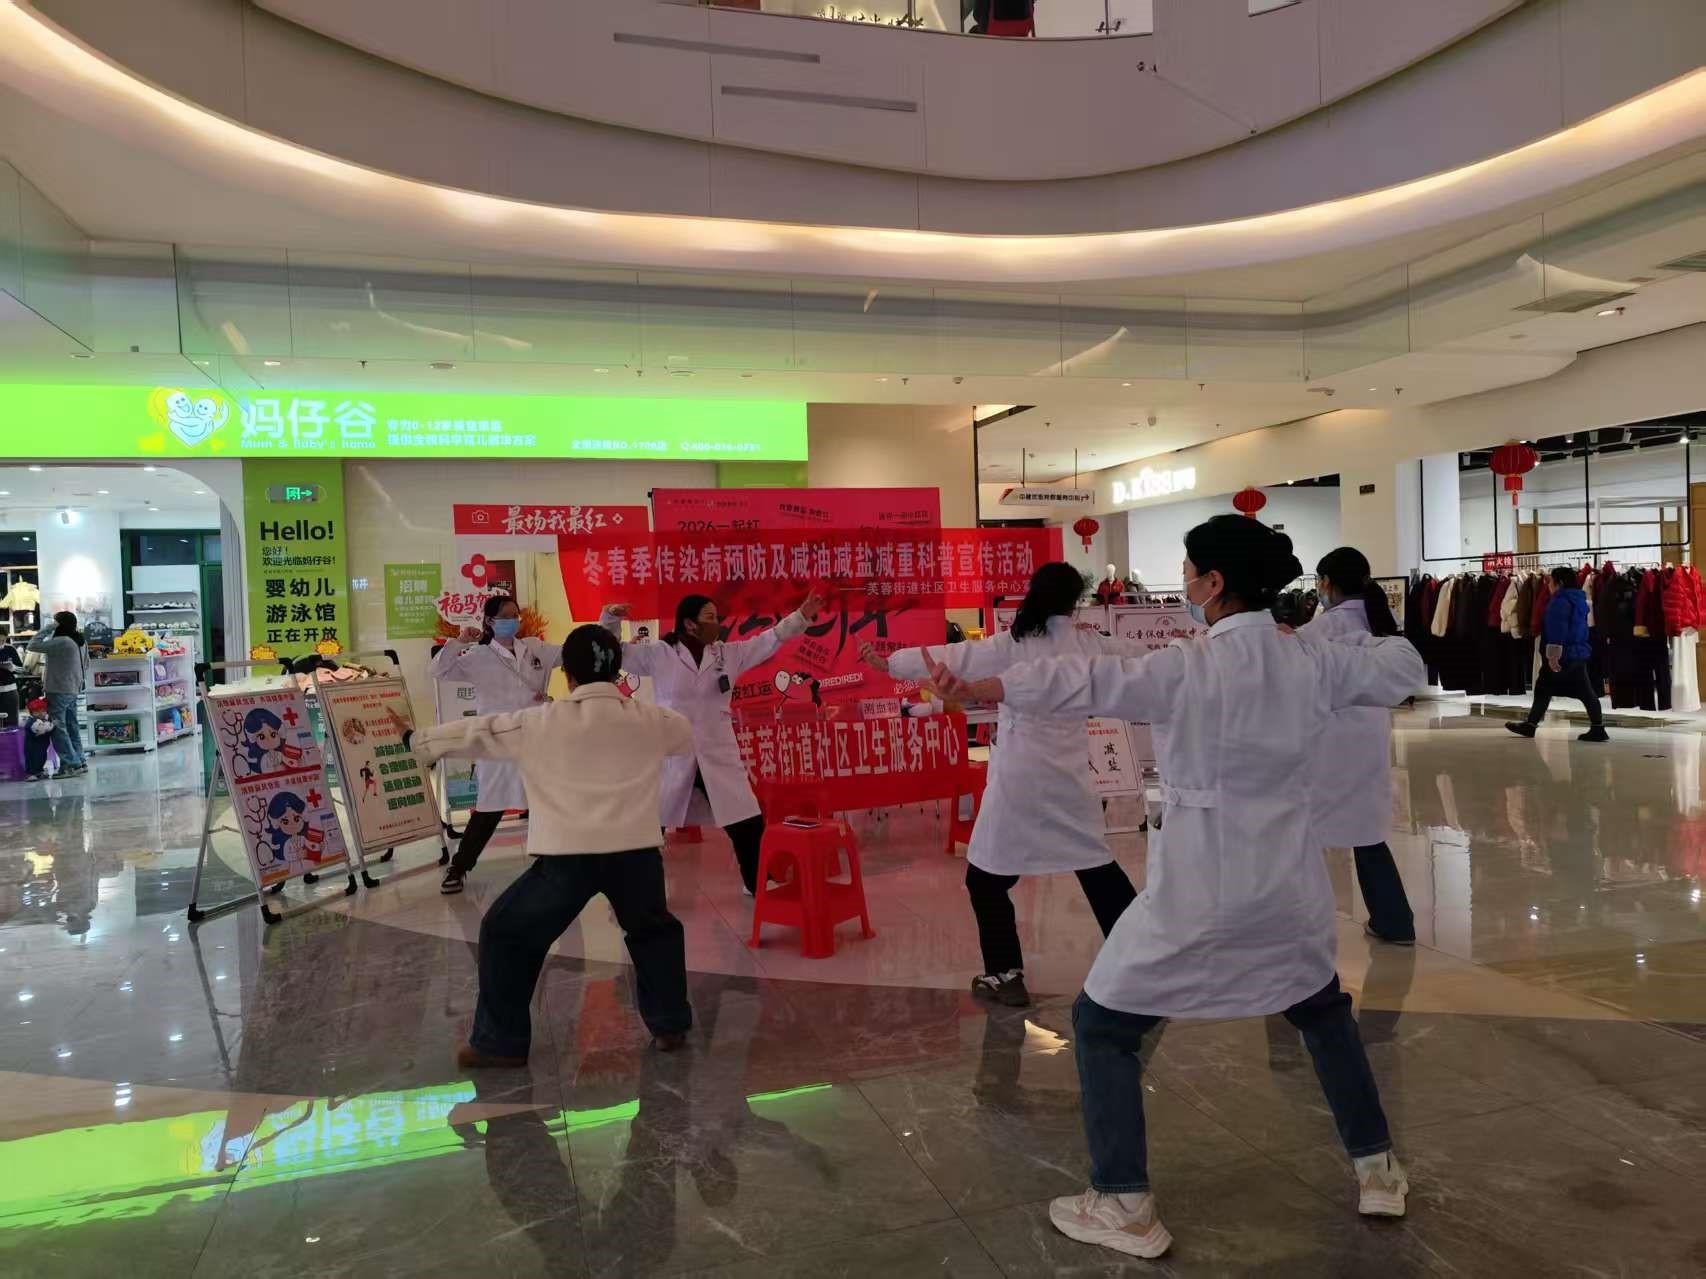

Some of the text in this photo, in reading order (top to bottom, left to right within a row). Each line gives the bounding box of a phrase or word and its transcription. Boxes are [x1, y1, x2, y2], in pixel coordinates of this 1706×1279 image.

[239, 399, 377, 439] 妈仔谷
[260, 519, 335, 541] Hello!
[583, 541, 1034, 586] 冬春季传染病预防及减油减盐减重科普宣传活动
[266, 578, 335, 598] 婴幼儿
[266, 603, 336, 623] 游泳馆
[266, 627, 337, 643] 正在开放
[737, 715, 960, 785] 芙蓉街道社区卫生服务中心
